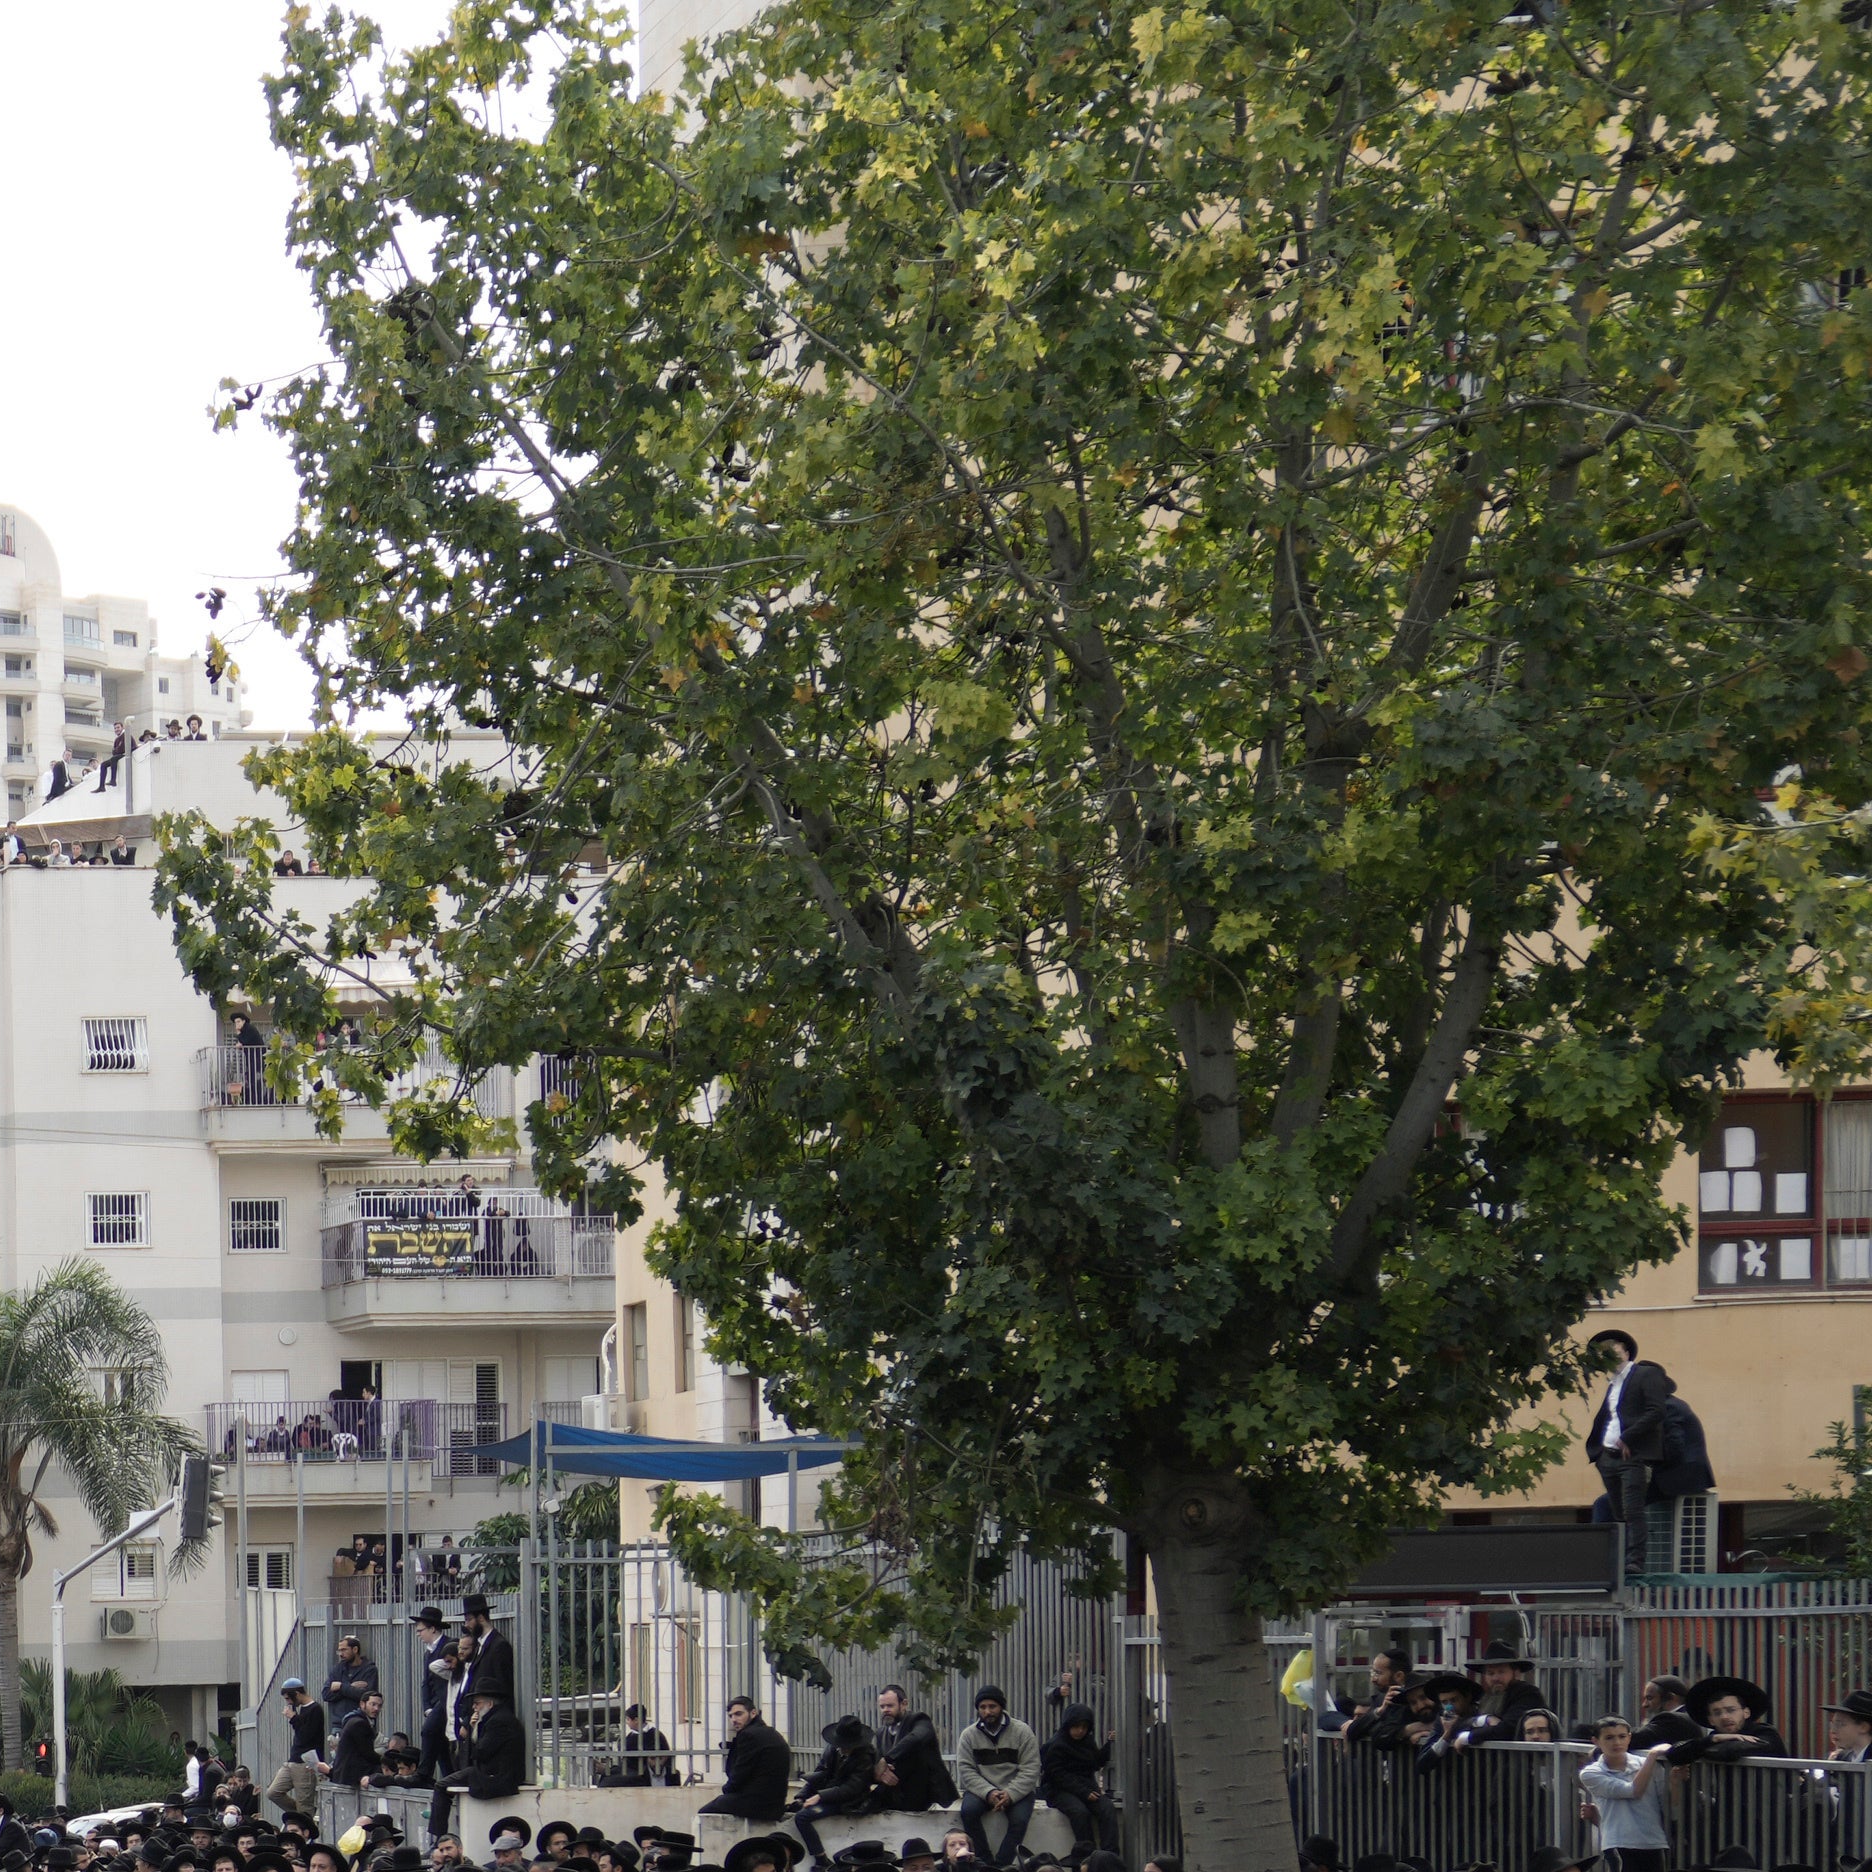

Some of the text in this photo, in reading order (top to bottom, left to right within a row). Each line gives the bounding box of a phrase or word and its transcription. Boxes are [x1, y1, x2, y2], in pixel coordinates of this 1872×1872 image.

[367, 1221, 471, 1232] ושמרו בני ישראל את
[367, 1231, 471, 1254] השבת
[418, 1254, 430, 1264] של
